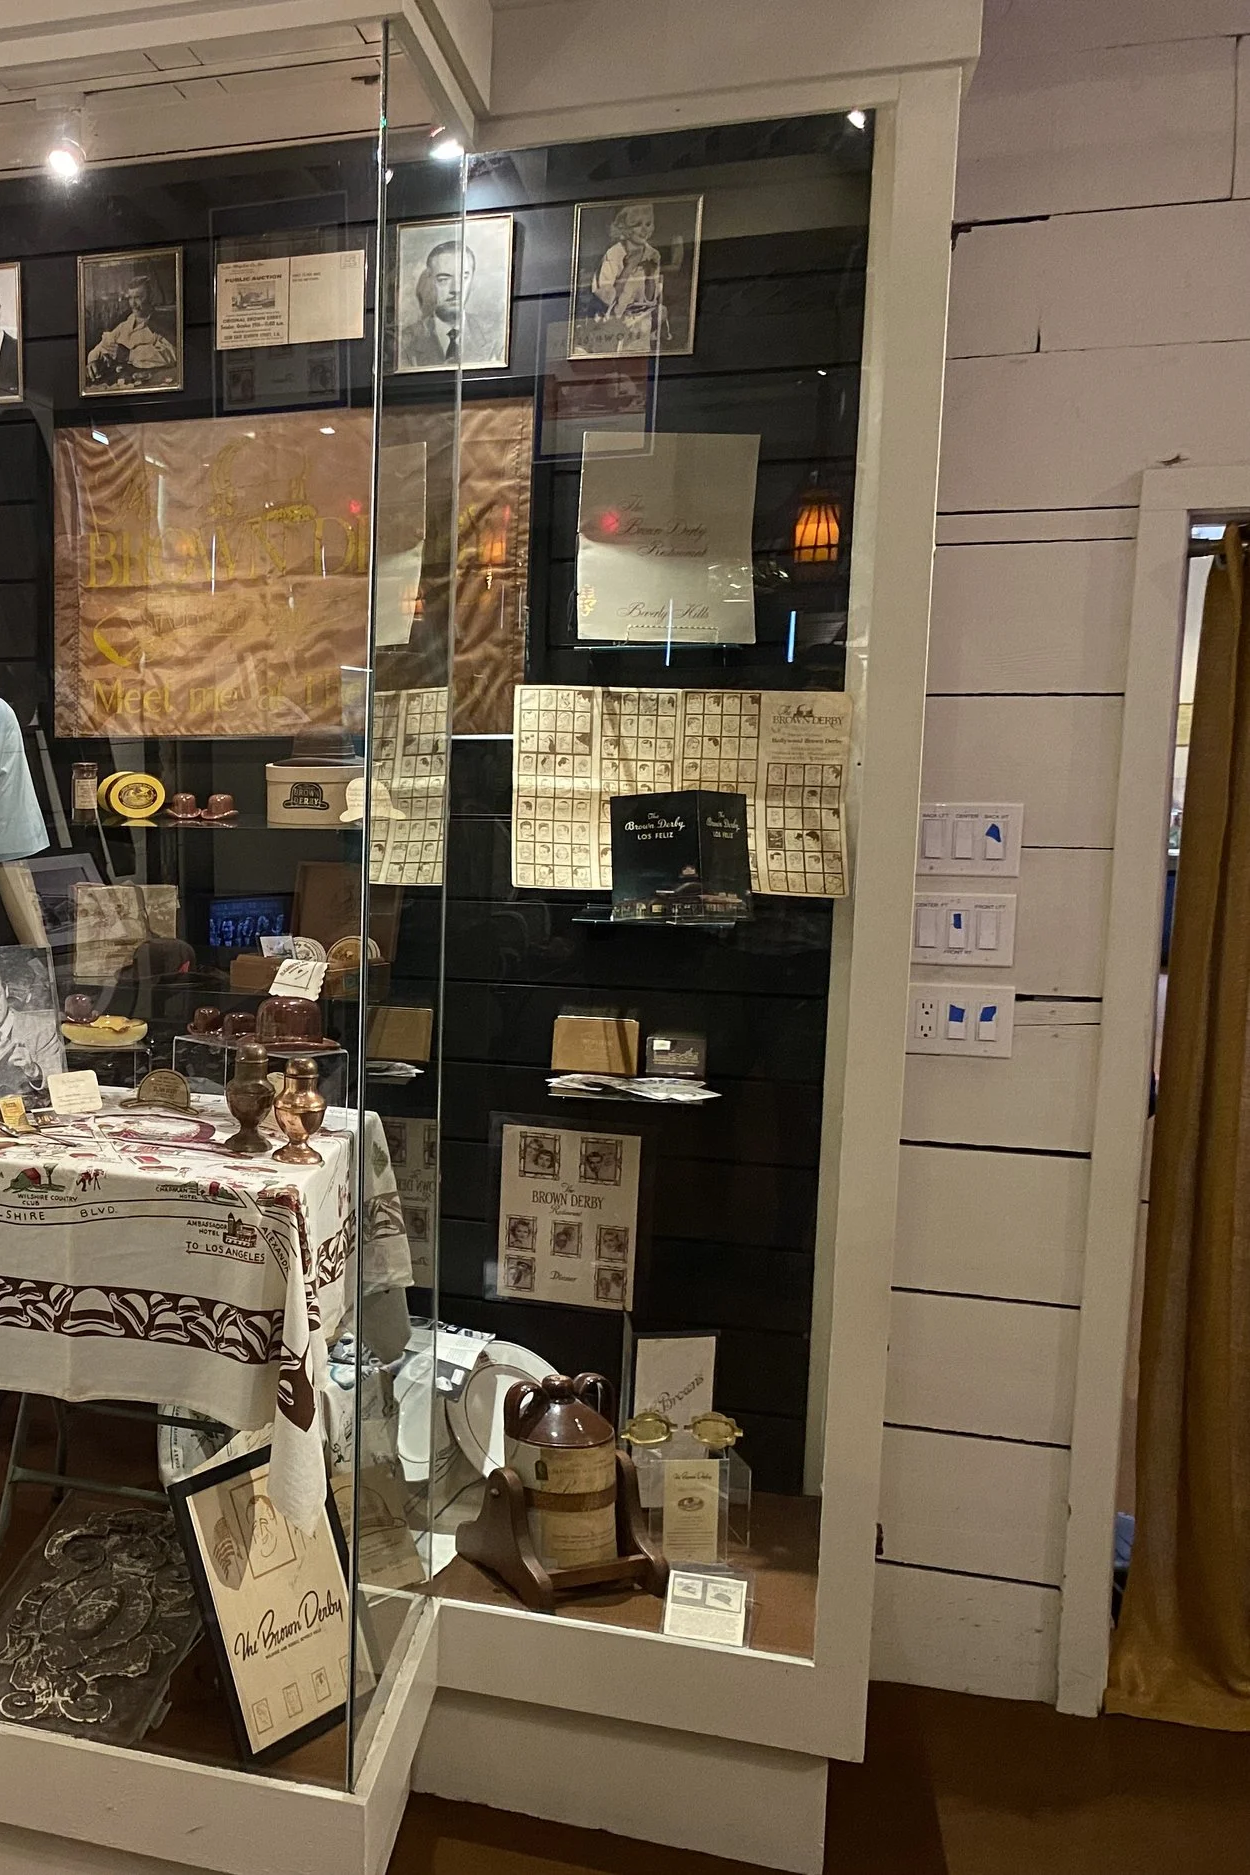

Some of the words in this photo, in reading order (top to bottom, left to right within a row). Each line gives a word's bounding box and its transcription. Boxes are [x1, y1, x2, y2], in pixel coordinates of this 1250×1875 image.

[251, 273, 283, 282] AUCTION
[624, 821, 655, 831] Brown
[657, 816, 686, 832] Derby
[17, 1193, 48, 1201] WILSHIRE
[50, 1194, 78, 1203] COUNTRY
[532, 1190, 568, 1206] BROWN
[570, 1194, 604, 1210] DERBY
[80, 1206, 118, 1218] BLVD.
[186, 1220, 228, 1230] AMBASSADOR
[198, 1229, 220, 1237] HOTEL
[185, 1241, 199, 1250] TO
[205, 1243, 224, 1254] LOS
[225, 1248, 266, 1262] ANGELES
[234, 1632, 259, 1661] The
[257, 1609, 302, 1651] Brown
[298, 1589, 344, 1629] Derby
